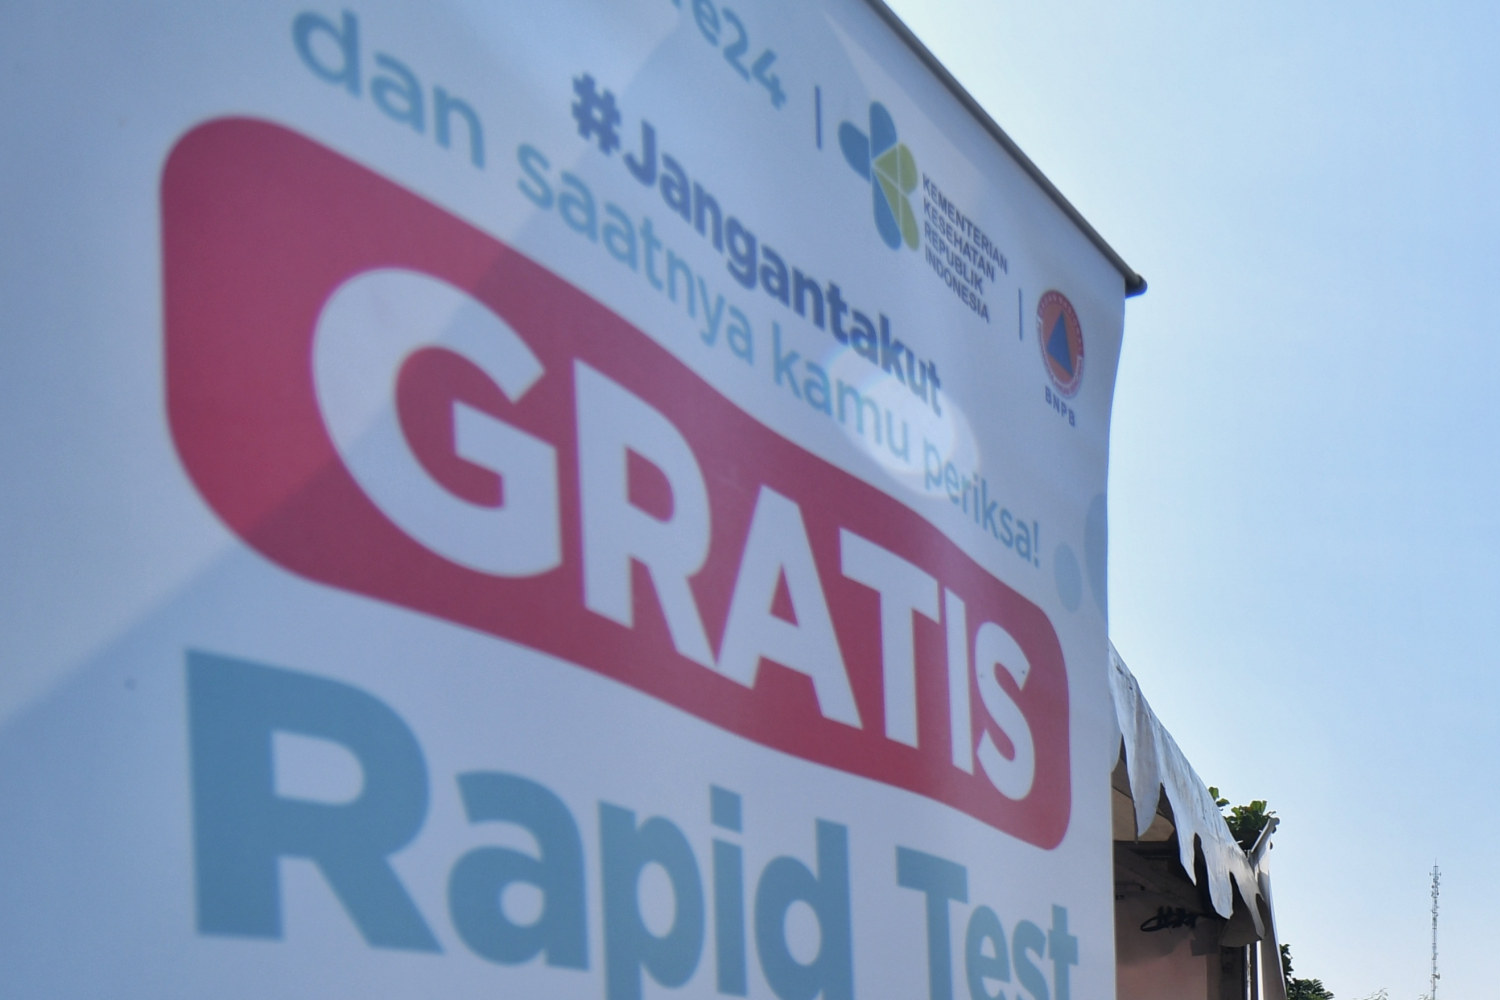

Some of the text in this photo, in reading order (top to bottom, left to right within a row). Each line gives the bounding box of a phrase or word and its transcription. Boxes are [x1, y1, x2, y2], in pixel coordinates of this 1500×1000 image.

[571, 72, 942, 418] #Jangantakut
[922, 172, 1008, 275] KEMENTERIAN
[923, 197, 995, 283] KESEHATAN
[924, 220, 984, 295] REPUBLIK
[291, 8, 486, 170] dan
[515, 142, 755, 366] saatnya
[771, 321, 911, 462] kamu
[923, 436, 1040, 568] periksa!
[925, 243, 991, 325] INDONESIA
[1044, 385, 1076, 427] BNPB
[311, 265, 1036, 801] GRATIS
